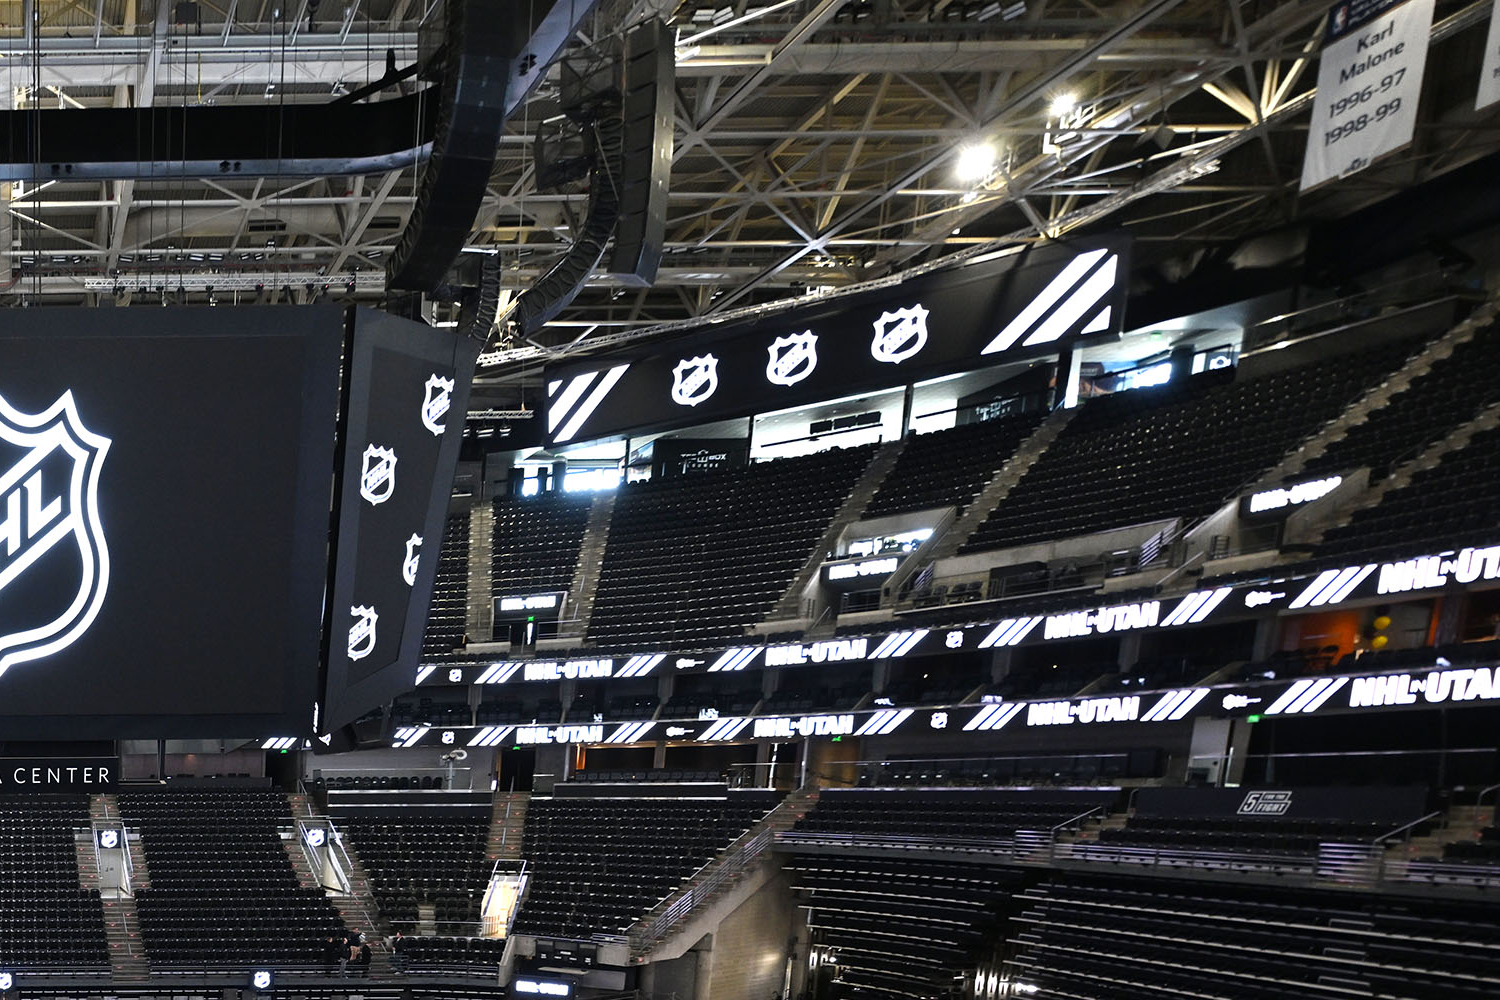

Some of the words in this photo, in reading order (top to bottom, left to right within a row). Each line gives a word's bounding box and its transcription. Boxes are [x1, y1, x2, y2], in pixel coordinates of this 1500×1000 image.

[1356, 20, 1395, 54] Karl
[1338, 42, 1405, 85] Malone
[1329, 67, 1407, 119] 1996-97
[1324, 97, 1402, 148] 1998-99
[1377, 556, 1447, 595] NHL
[1044, 611, 1092, 640] NHL
[1096, 601, 1160, 634] UTAH
[811, 639, 868, 663] UTAH
[566, 659, 613, 680] UTAH
[1349, 673, 1417, 707] NHL
[800, 715, 854, 736] UTAH
[1027, 701, 1075, 726] NHL
[1079, 696, 1140, 724] UTAH
[556, 725, 604, 744] UTAH
[13, 767, 110, 784] CENTER
[1243, 794, 1260, 811] 5
[1256, 803, 1286, 812] FIGHT
